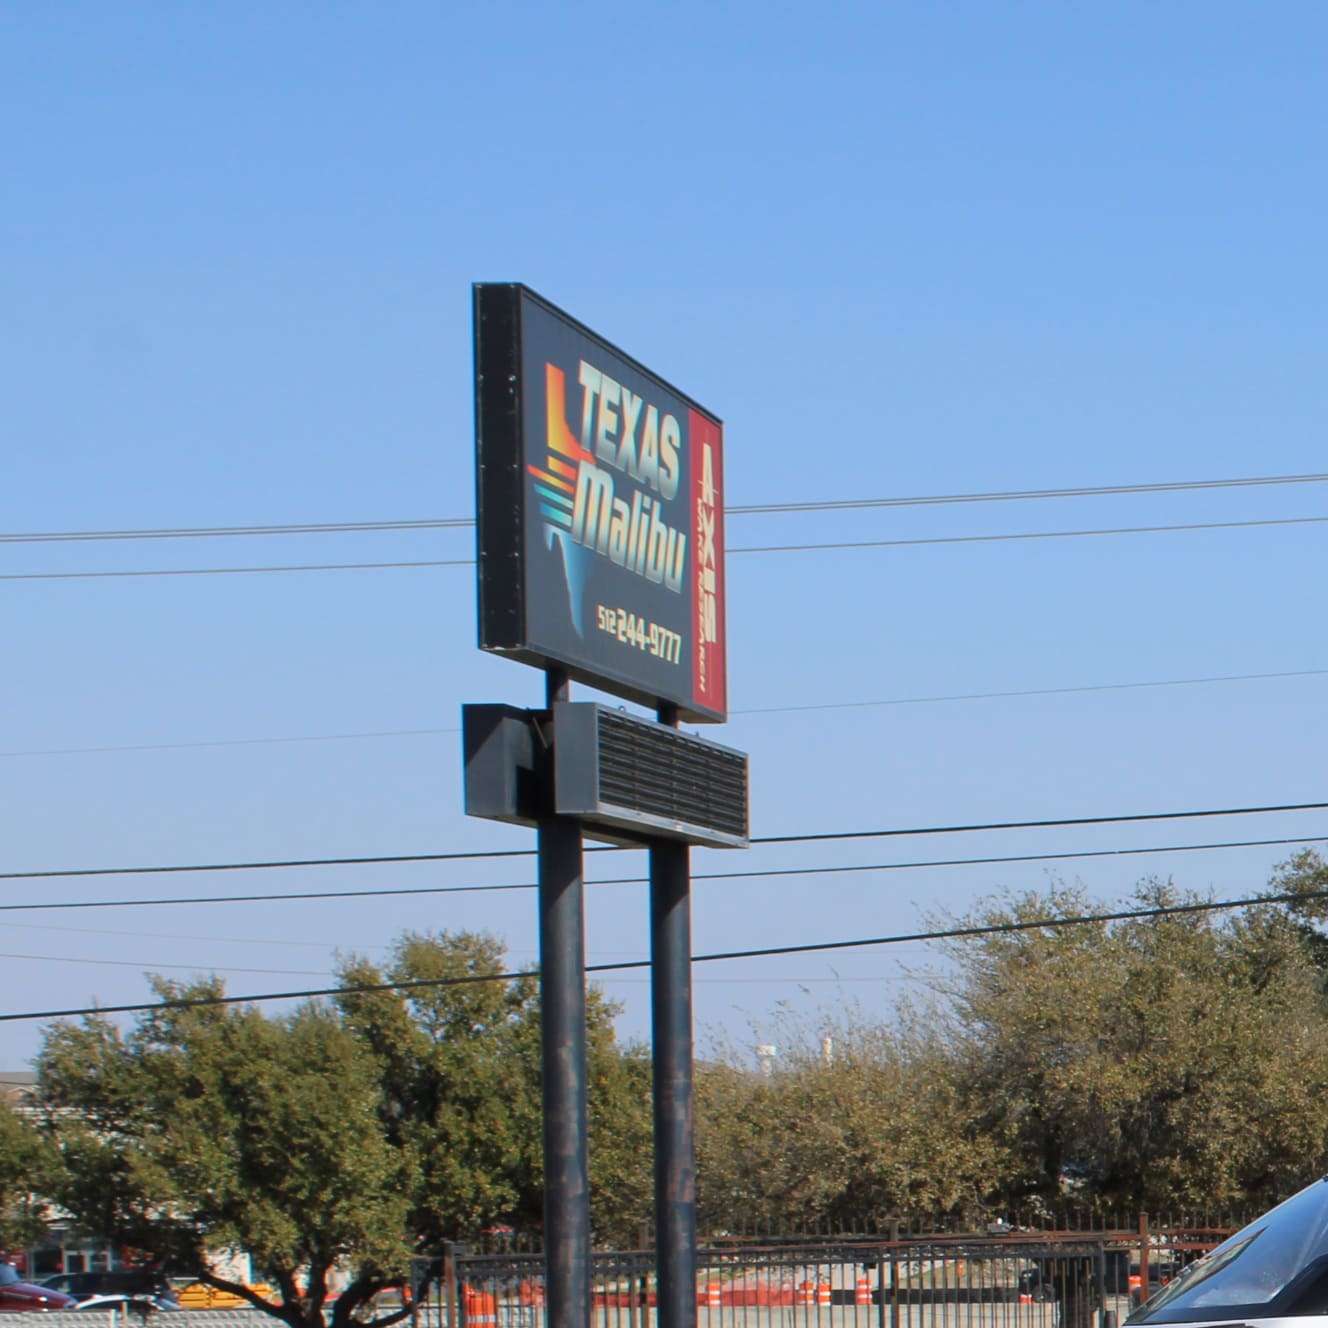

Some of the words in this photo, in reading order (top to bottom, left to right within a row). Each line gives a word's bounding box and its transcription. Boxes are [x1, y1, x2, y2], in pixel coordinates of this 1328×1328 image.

[578, 359, 682, 501] TEXAS
[572, 459, 687, 595] Malibu
[698, 442, 718, 643] AXIS
[597, 604, 617, 635] 512
[616, 607, 682, 665] 244-9777
